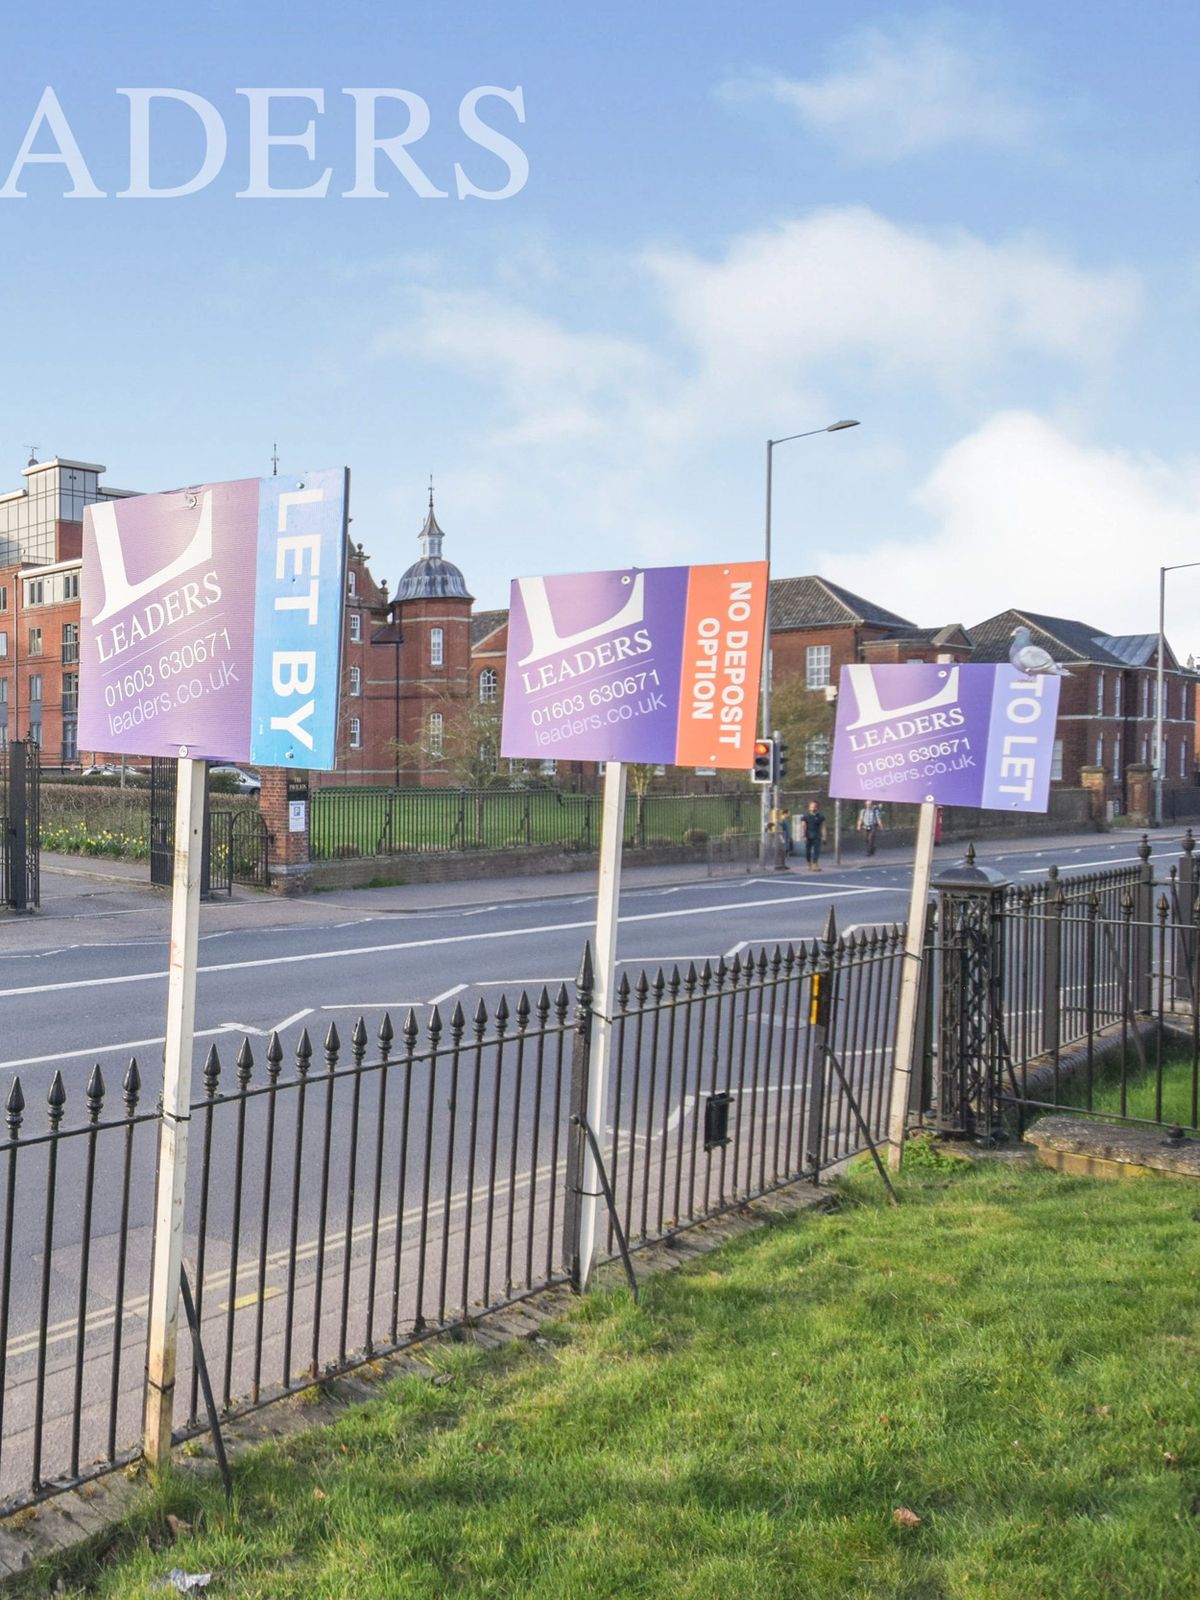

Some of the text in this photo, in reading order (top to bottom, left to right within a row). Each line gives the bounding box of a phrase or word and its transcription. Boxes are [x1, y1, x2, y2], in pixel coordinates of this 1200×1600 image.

[94, 571, 222, 664] LEADERS
[270, 488, 324, 749] LET BY
[104, 627, 232, 707] 01603 630671
[108, 660, 240, 736] leaders.co.uk
[522, 628, 653, 695] LEADERS
[531, 669, 661, 726] 01603 630671
[692, 617, 721, 720] OPTION
[719, 581, 753, 749] NO DEPOSIT
[535, 691, 668, 747] leaders.co.uk
[848, 707, 965, 752] LEADERS
[856, 737, 971, 776] 01603 630671
[999, 674, 1044, 802] TO LET
[860, 753, 977, 791] leaders.co.uk
